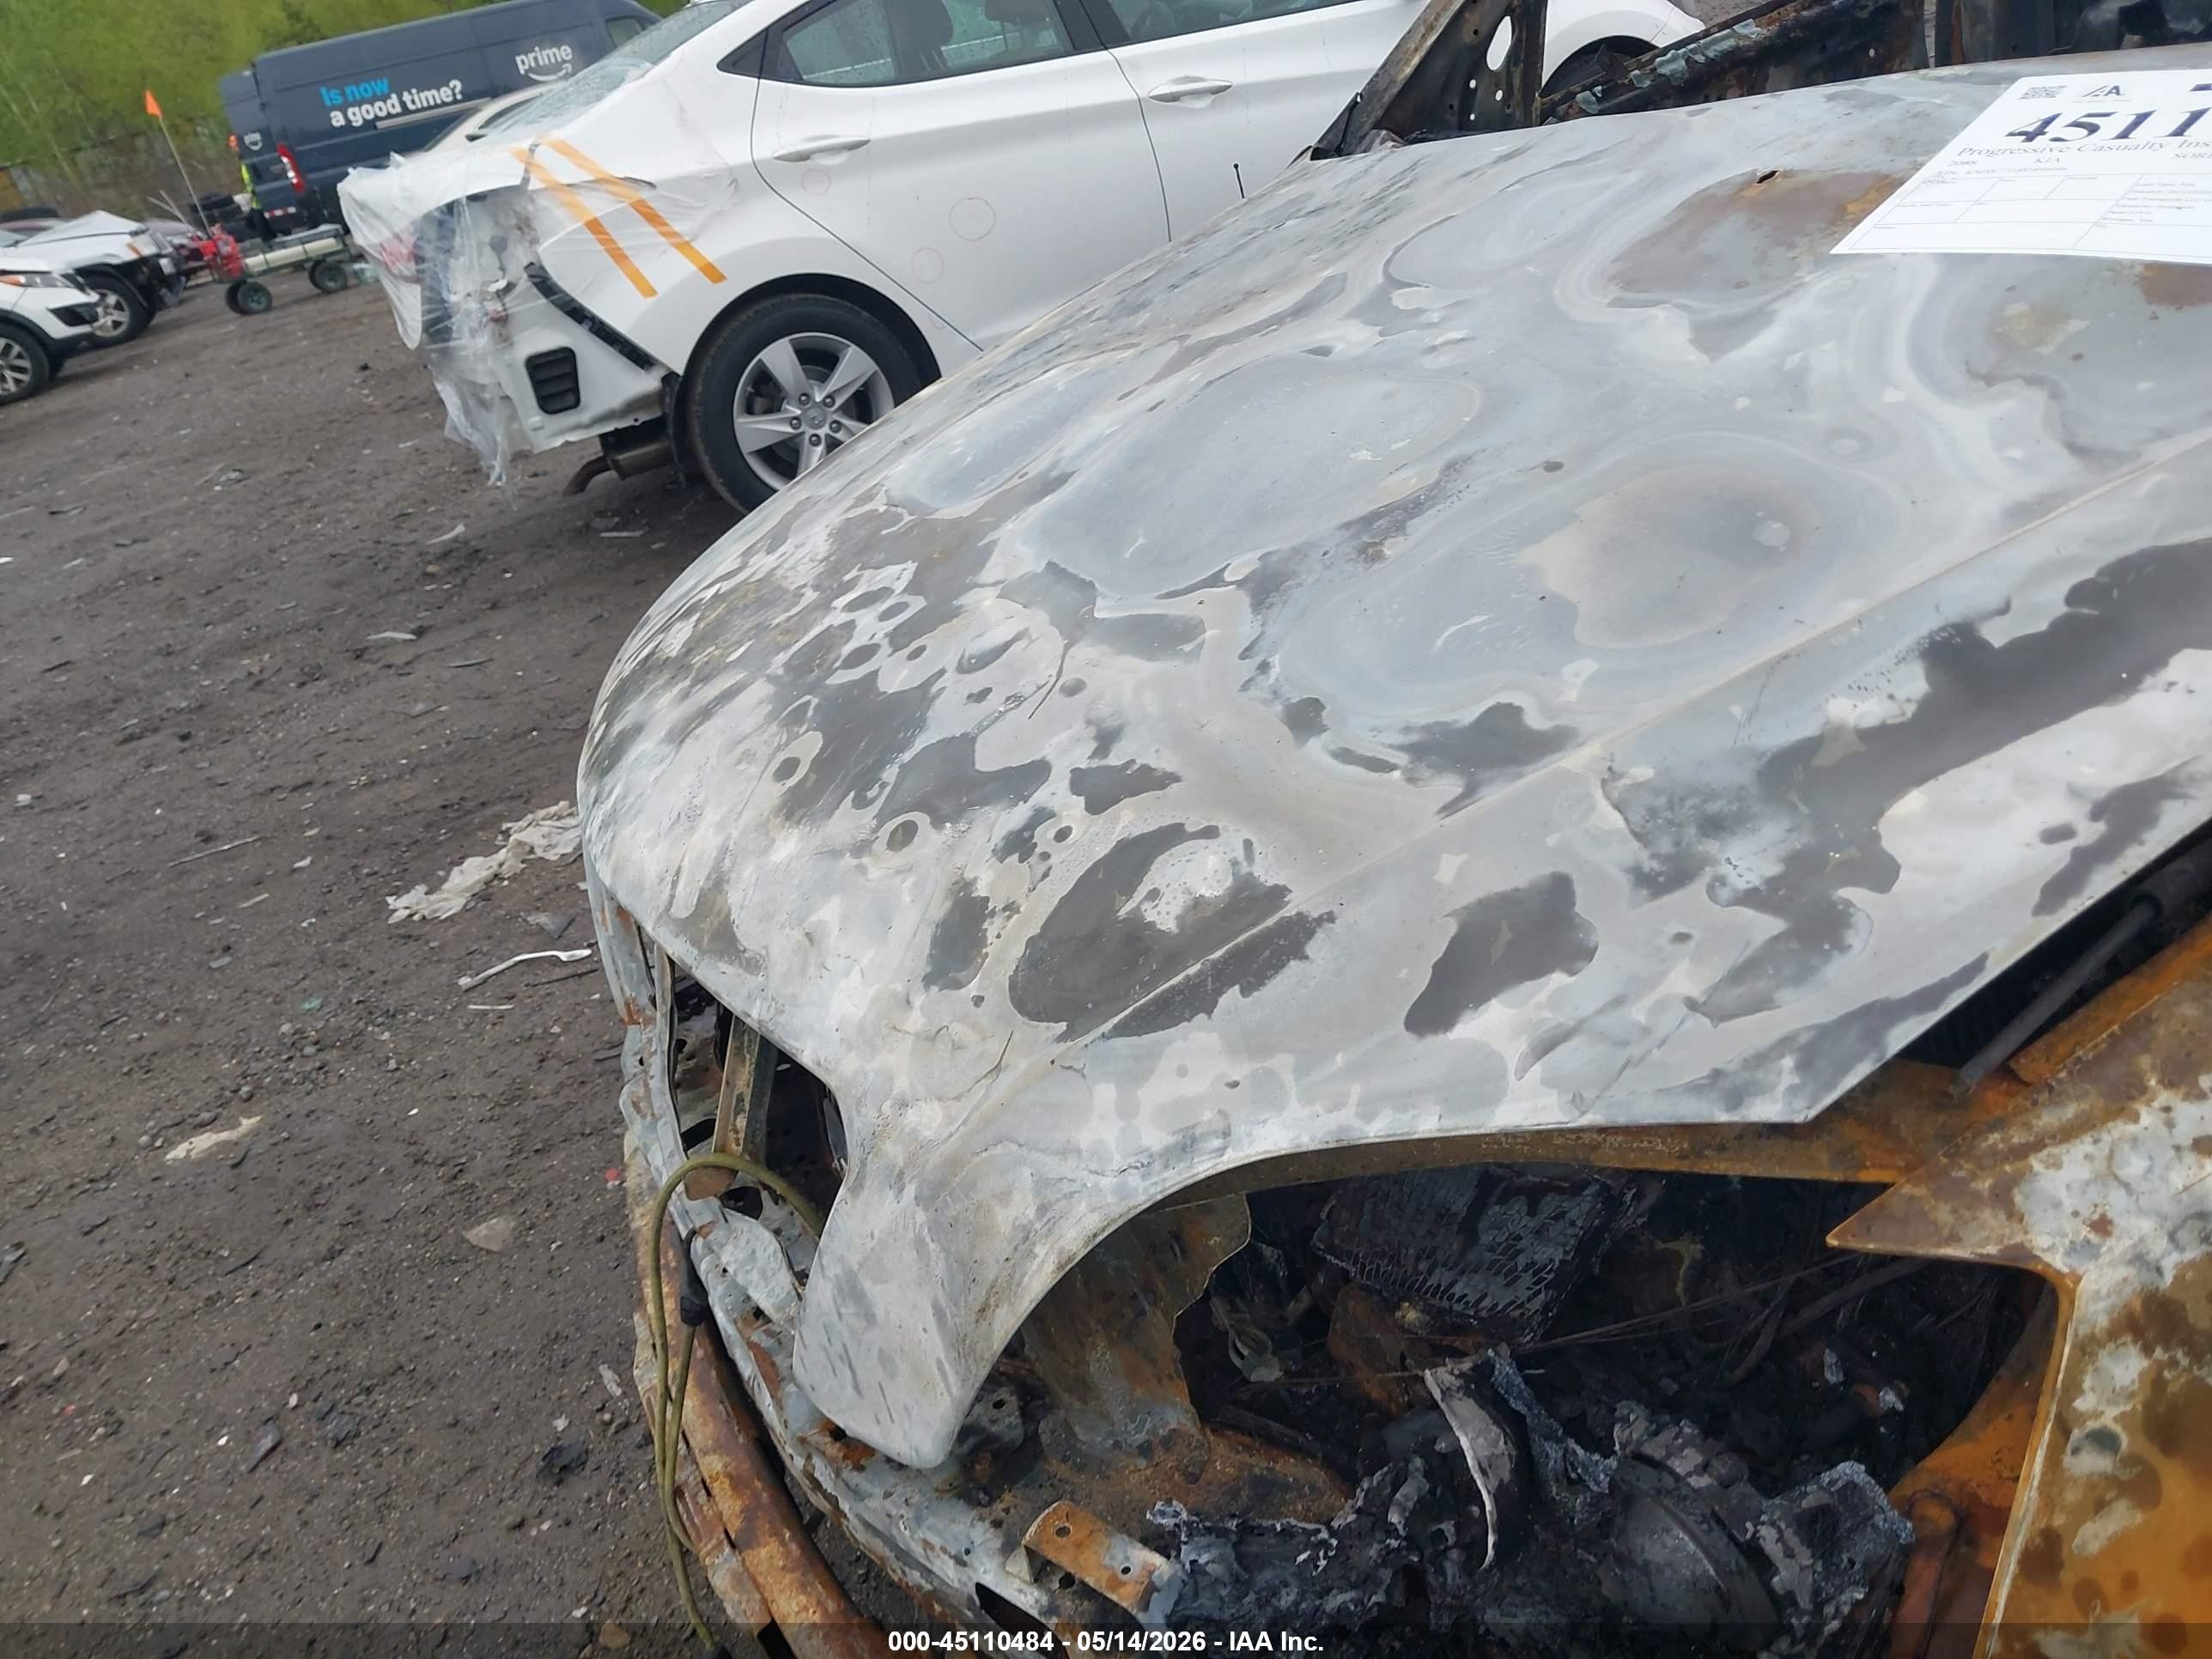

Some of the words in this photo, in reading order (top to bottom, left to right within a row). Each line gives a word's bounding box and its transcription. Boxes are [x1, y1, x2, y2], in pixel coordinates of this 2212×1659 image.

[514, 43, 574, 76] prime
[319, 85, 343, 107] Is
[347, 77, 389, 100] now
[330, 111, 346, 128] a
[348, 95, 401, 127] good
[401, 79, 464, 111] time?
[1957, 147, 2071, 158] Progressive
[2076, 141, 2171, 152] Casualty
